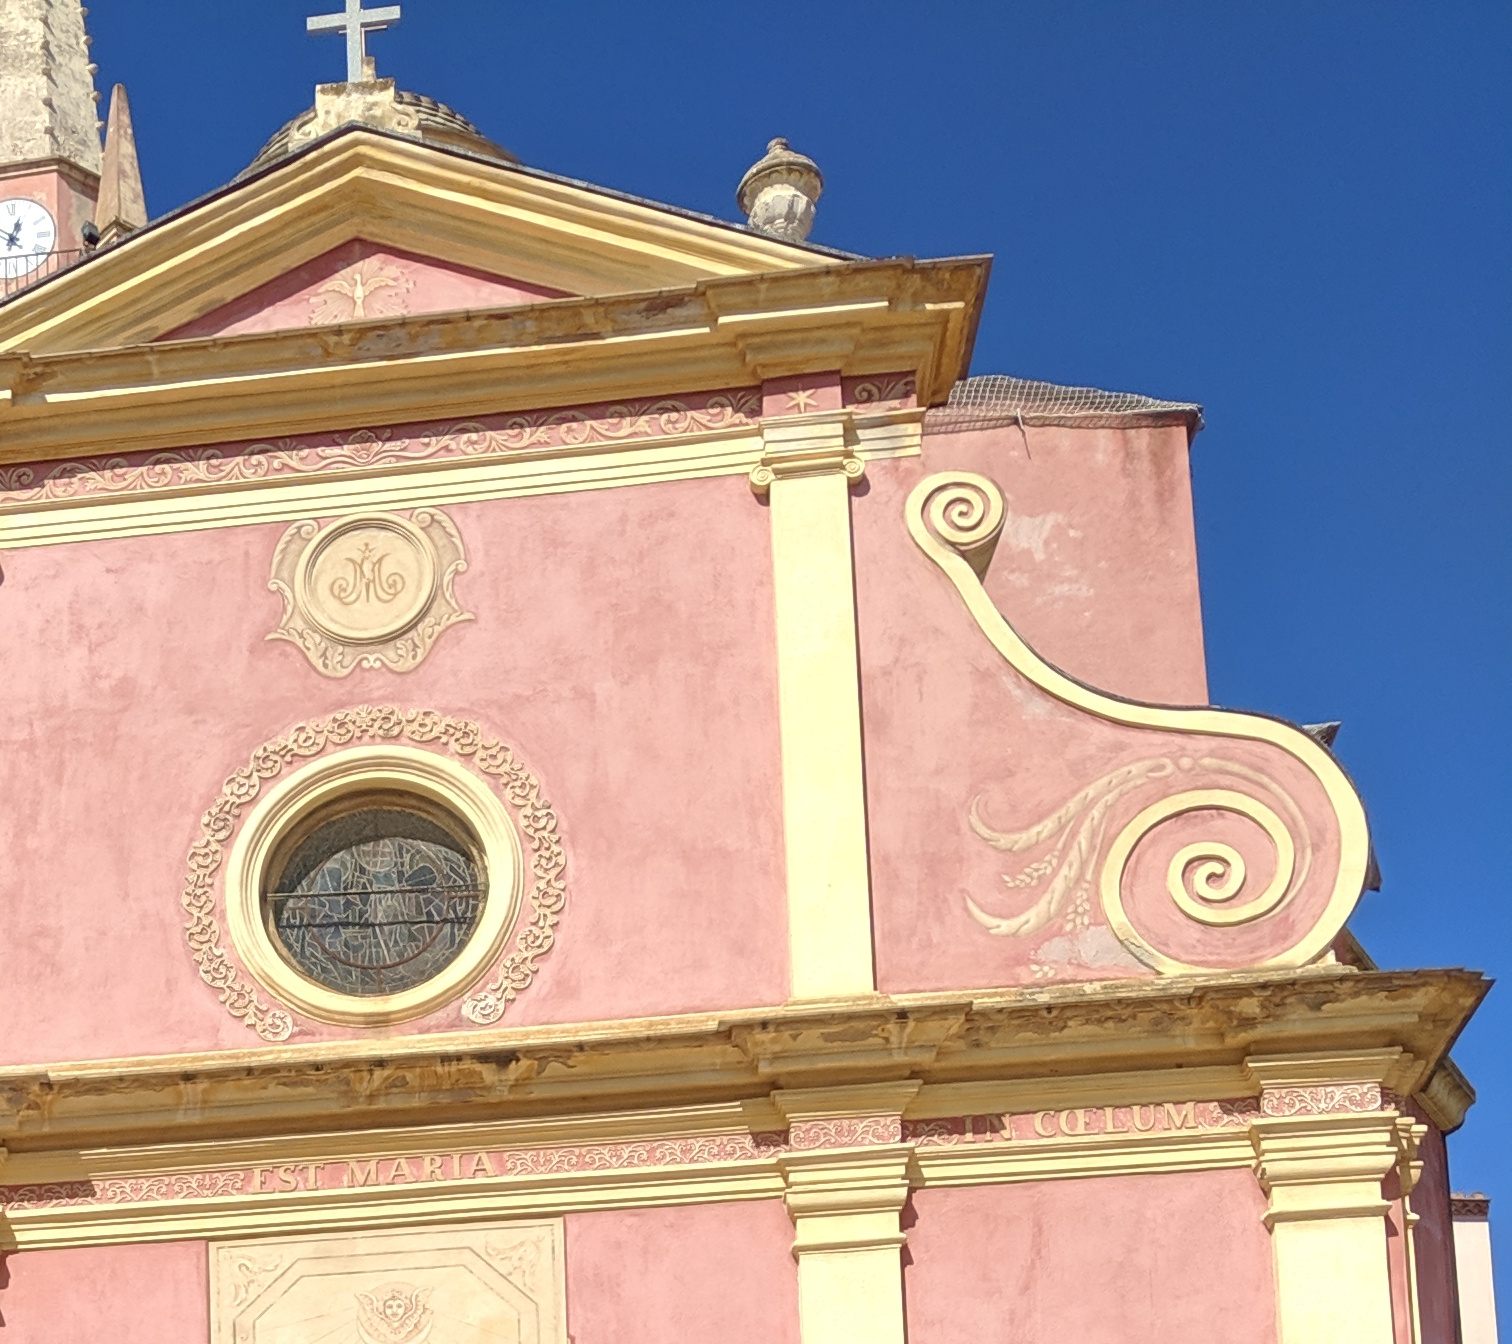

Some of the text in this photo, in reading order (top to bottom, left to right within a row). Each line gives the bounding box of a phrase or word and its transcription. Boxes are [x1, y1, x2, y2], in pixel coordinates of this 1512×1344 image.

[963, 1112, 1014, 1144] IN
[251, 1151, 498, 1194] EST MARIA
